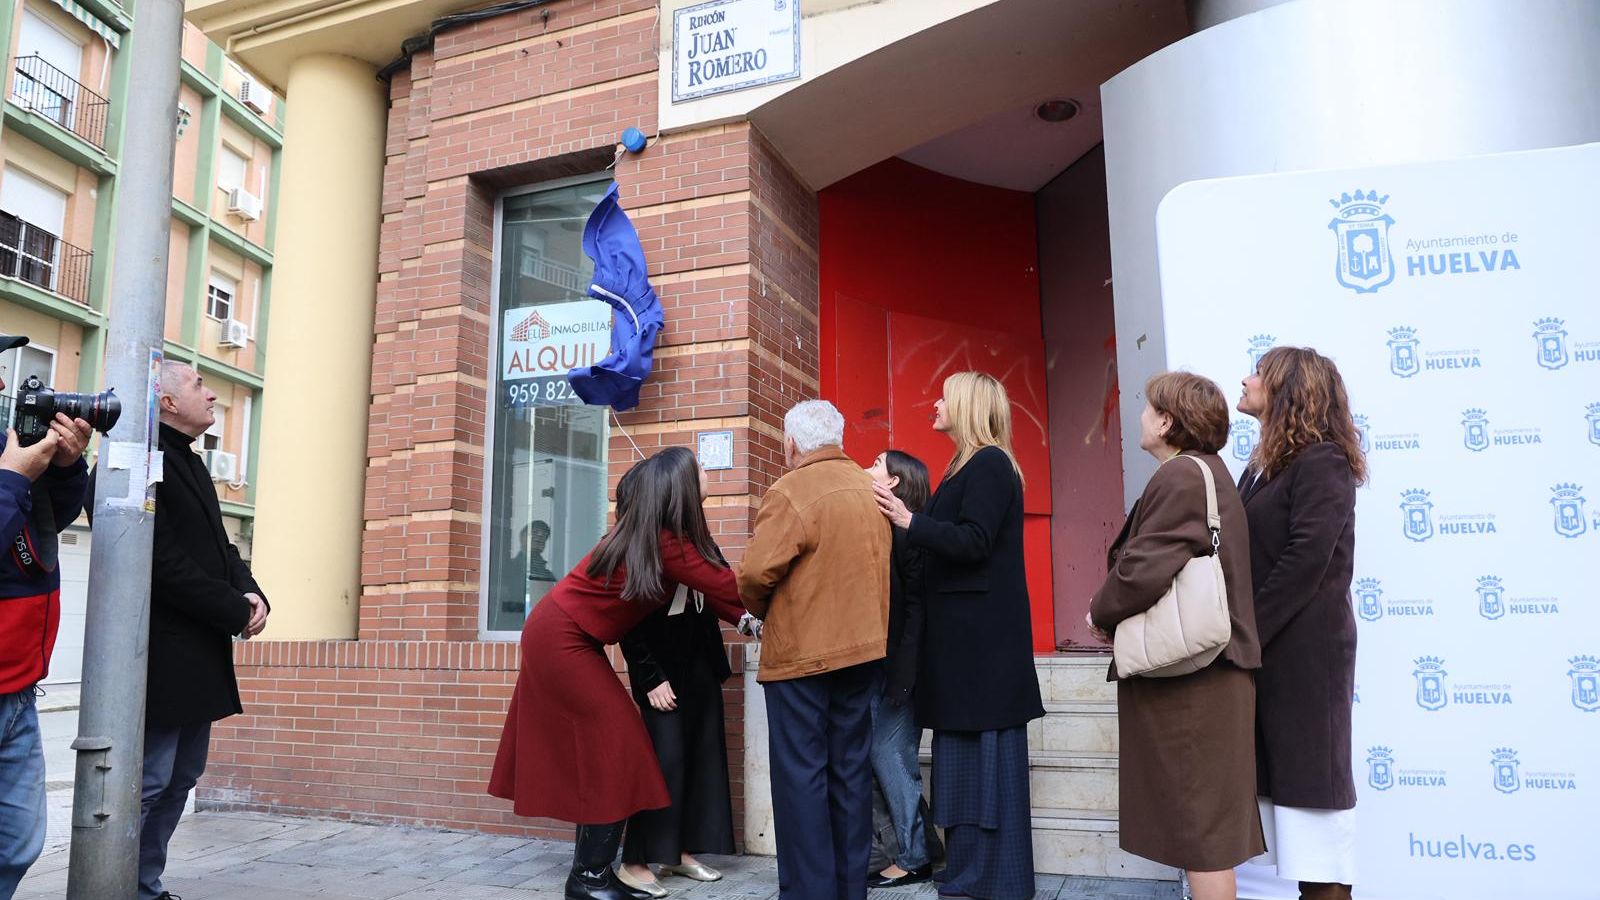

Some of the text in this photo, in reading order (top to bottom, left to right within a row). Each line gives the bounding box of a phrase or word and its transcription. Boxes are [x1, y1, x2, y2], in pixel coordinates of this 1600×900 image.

[689, 11, 725, 30] RINCÓN
[688, 28, 736, 59] JUAN
[688, 48, 767, 87] ROMERO
[1406, 232, 1518, 252] Ayuntamiento de
[1407, 249, 1520, 276] HUELVA
[508, 342, 612, 374] ALQUIL
[1426, 357, 1480, 369] HUELVA
[509, 383, 539, 404] 959
[1375, 440, 1420, 450] HUELVA
[1494, 435, 1541, 445] HUELVA
[1440, 522, 1496, 534] HUELVA
[1388, 606, 1434, 615] HUELVA
[1510, 604, 1558, 613] HUELVA
[1453, 692, 1512, 704] HUELVA
[1399, 776, 1446, 786] HUELVA
[1525, 779, 1576, 790] HUELVA
[1409, 832, 1536, 861] huelva.es
